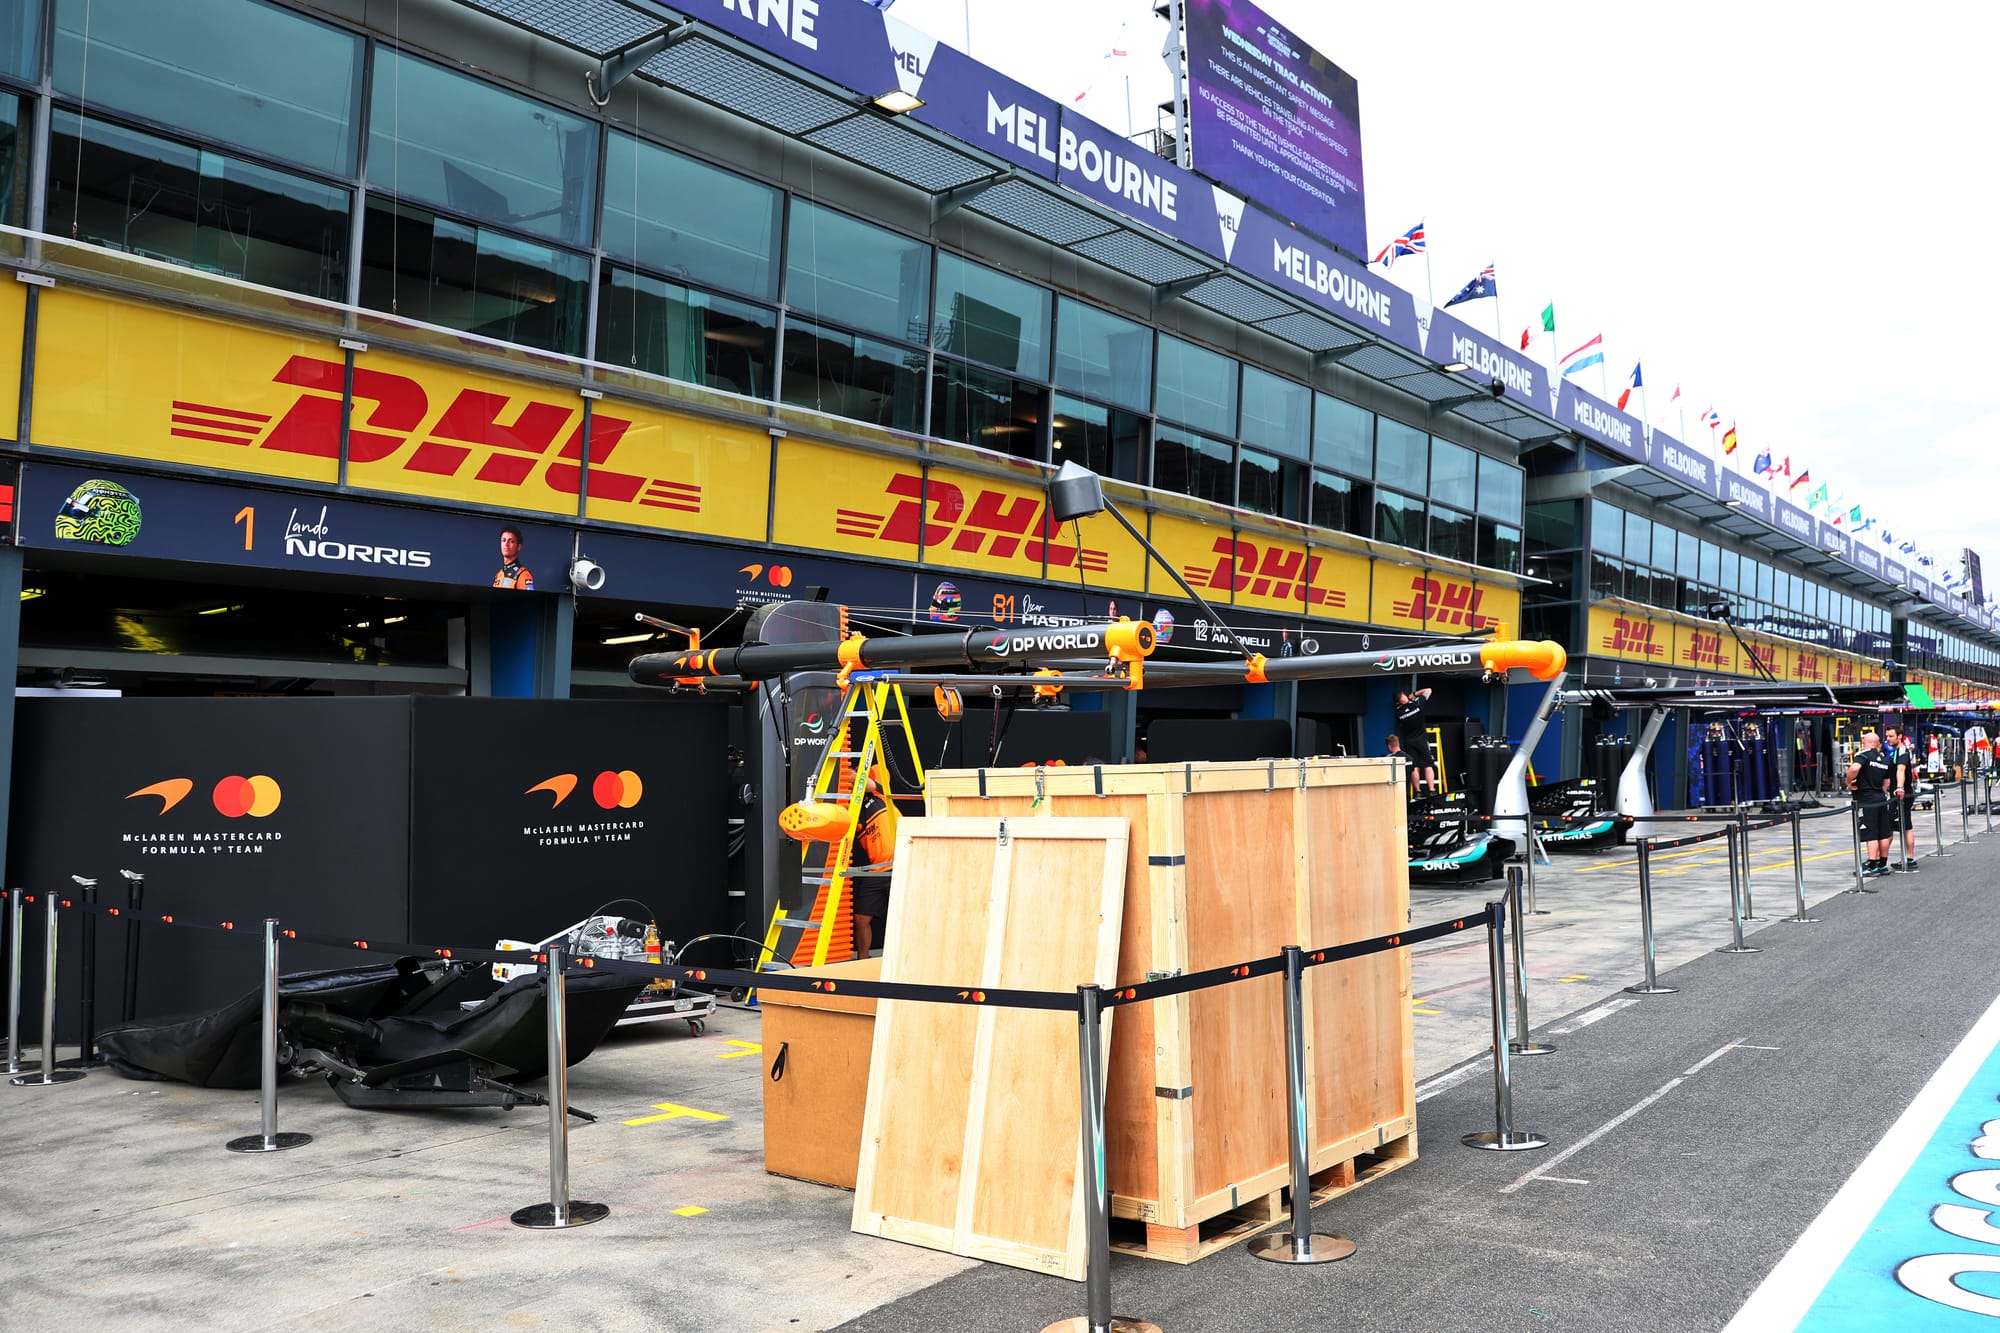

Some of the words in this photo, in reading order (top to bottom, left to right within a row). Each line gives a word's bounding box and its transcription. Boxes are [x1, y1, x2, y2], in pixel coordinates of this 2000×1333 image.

[892, 45, 925, 78] MEL
[1222, 46, 1235, 62] THIS
[1237, 57, 1241, 67] IS
[1243, 61, 1252, 74] AN
[1254, 68, 1287, 97] IMPORTANT
[1288, 91, 1309, 112] SAFETY
[1223, 25, 1272, 68] WEDNESDAY
[1273, 60, 1298, 86] TRACK
[1300, 78, 1332, 109] ACTIVITY
[1209, 59, 1229, 80] THERE
[1231, 74, 1243, 89] ARE
[1245, 83, 1272, 107] VEHICLES
[1273, 101, 1306, 130] TRAVELLING
[1307, 124, 1315, 135] AT
[1316, 130, 1328, 144] HIGH
[1329, 138, 1348, 157] SPEEDS
[1263, 105, 1271, 117] ON
[1272, 111, 1284, 125] THE
[987, 90, 1178, 222] MELBOURNE
[1200, 87, 1209, 100] NO
[1211, 93, 1235, 115] ACCESS
[1236, 109, 1244, 121] TO
[1246, 115, 1258, 130] THE
[1259, 123, 1277, 141] TRACK
[1303, 151, 1311, 163] OR
[1346, 178, 1357, 192] WILL
[1217, 108, 1225, 120] BE
[1227, 114, 1261, 142] PERMITTED
[1262, 136, 1279, 153] UNTIL
[1280, 147, 1325, 181] APPROXIMATELY
[1232, 139, 1254, 159] THANK
[1255, 152, 1267, 166] YOU
[1269, 161, 1280, 174] FOR
[1282, 169, 1296, 184] YOUR
[1218, 211, 1239, 234] MEL
[1273, 237, 1391, 328] MELBOURNE
[1452, 331, 1533, 398] MELBOURNE
[260, 354, 648, 503] DHL
[1574, 397, 1632, 448] MELBOURNE
[1662, 443, 1707, 484] MELBOURNE
[1729, 480, 1764, 513] MELBOURNE
[234, 506, 255, 551] 1
[284, 505, 329, 540] Lando
[879, 473, 1079, 567] DHL
[285, 538, 432, 568] NORRIS
[1208, 536, 1328, 605] DHL
[992, 593, 1015, 623] 81
[1022, 594, 1045, 615] Oscar
[1409, 576, 1488, 626] DHL
[1012, 636, 1035, 652] DP
[1037, 633, 1099, 650] WORLD
[1194, 619, 1208, 641] 12
[1612, 617, 1657, 655] DHL
[1396, 655, 1416, 668] DP
[1417, 653, 1472, 667] WORLD
[1690, 632, 1724, 665] DHL
[794, 737, 807, 746] DP
[807, 737, 827, 746] WOR
[123, 833, 185, 842] McLAREN
[193, 832, 282, 841] MASTERCARD
[523, 825, 573, 835] McLAREN
[578, 820, 644, 832] MASTERCARD
[539, 835, 589, 846] FORMULA
[605, 833, 631, 842] TEAM
[142, 846, 206, 855] FORMULA
[228, 845, 263, 853] TEAM
